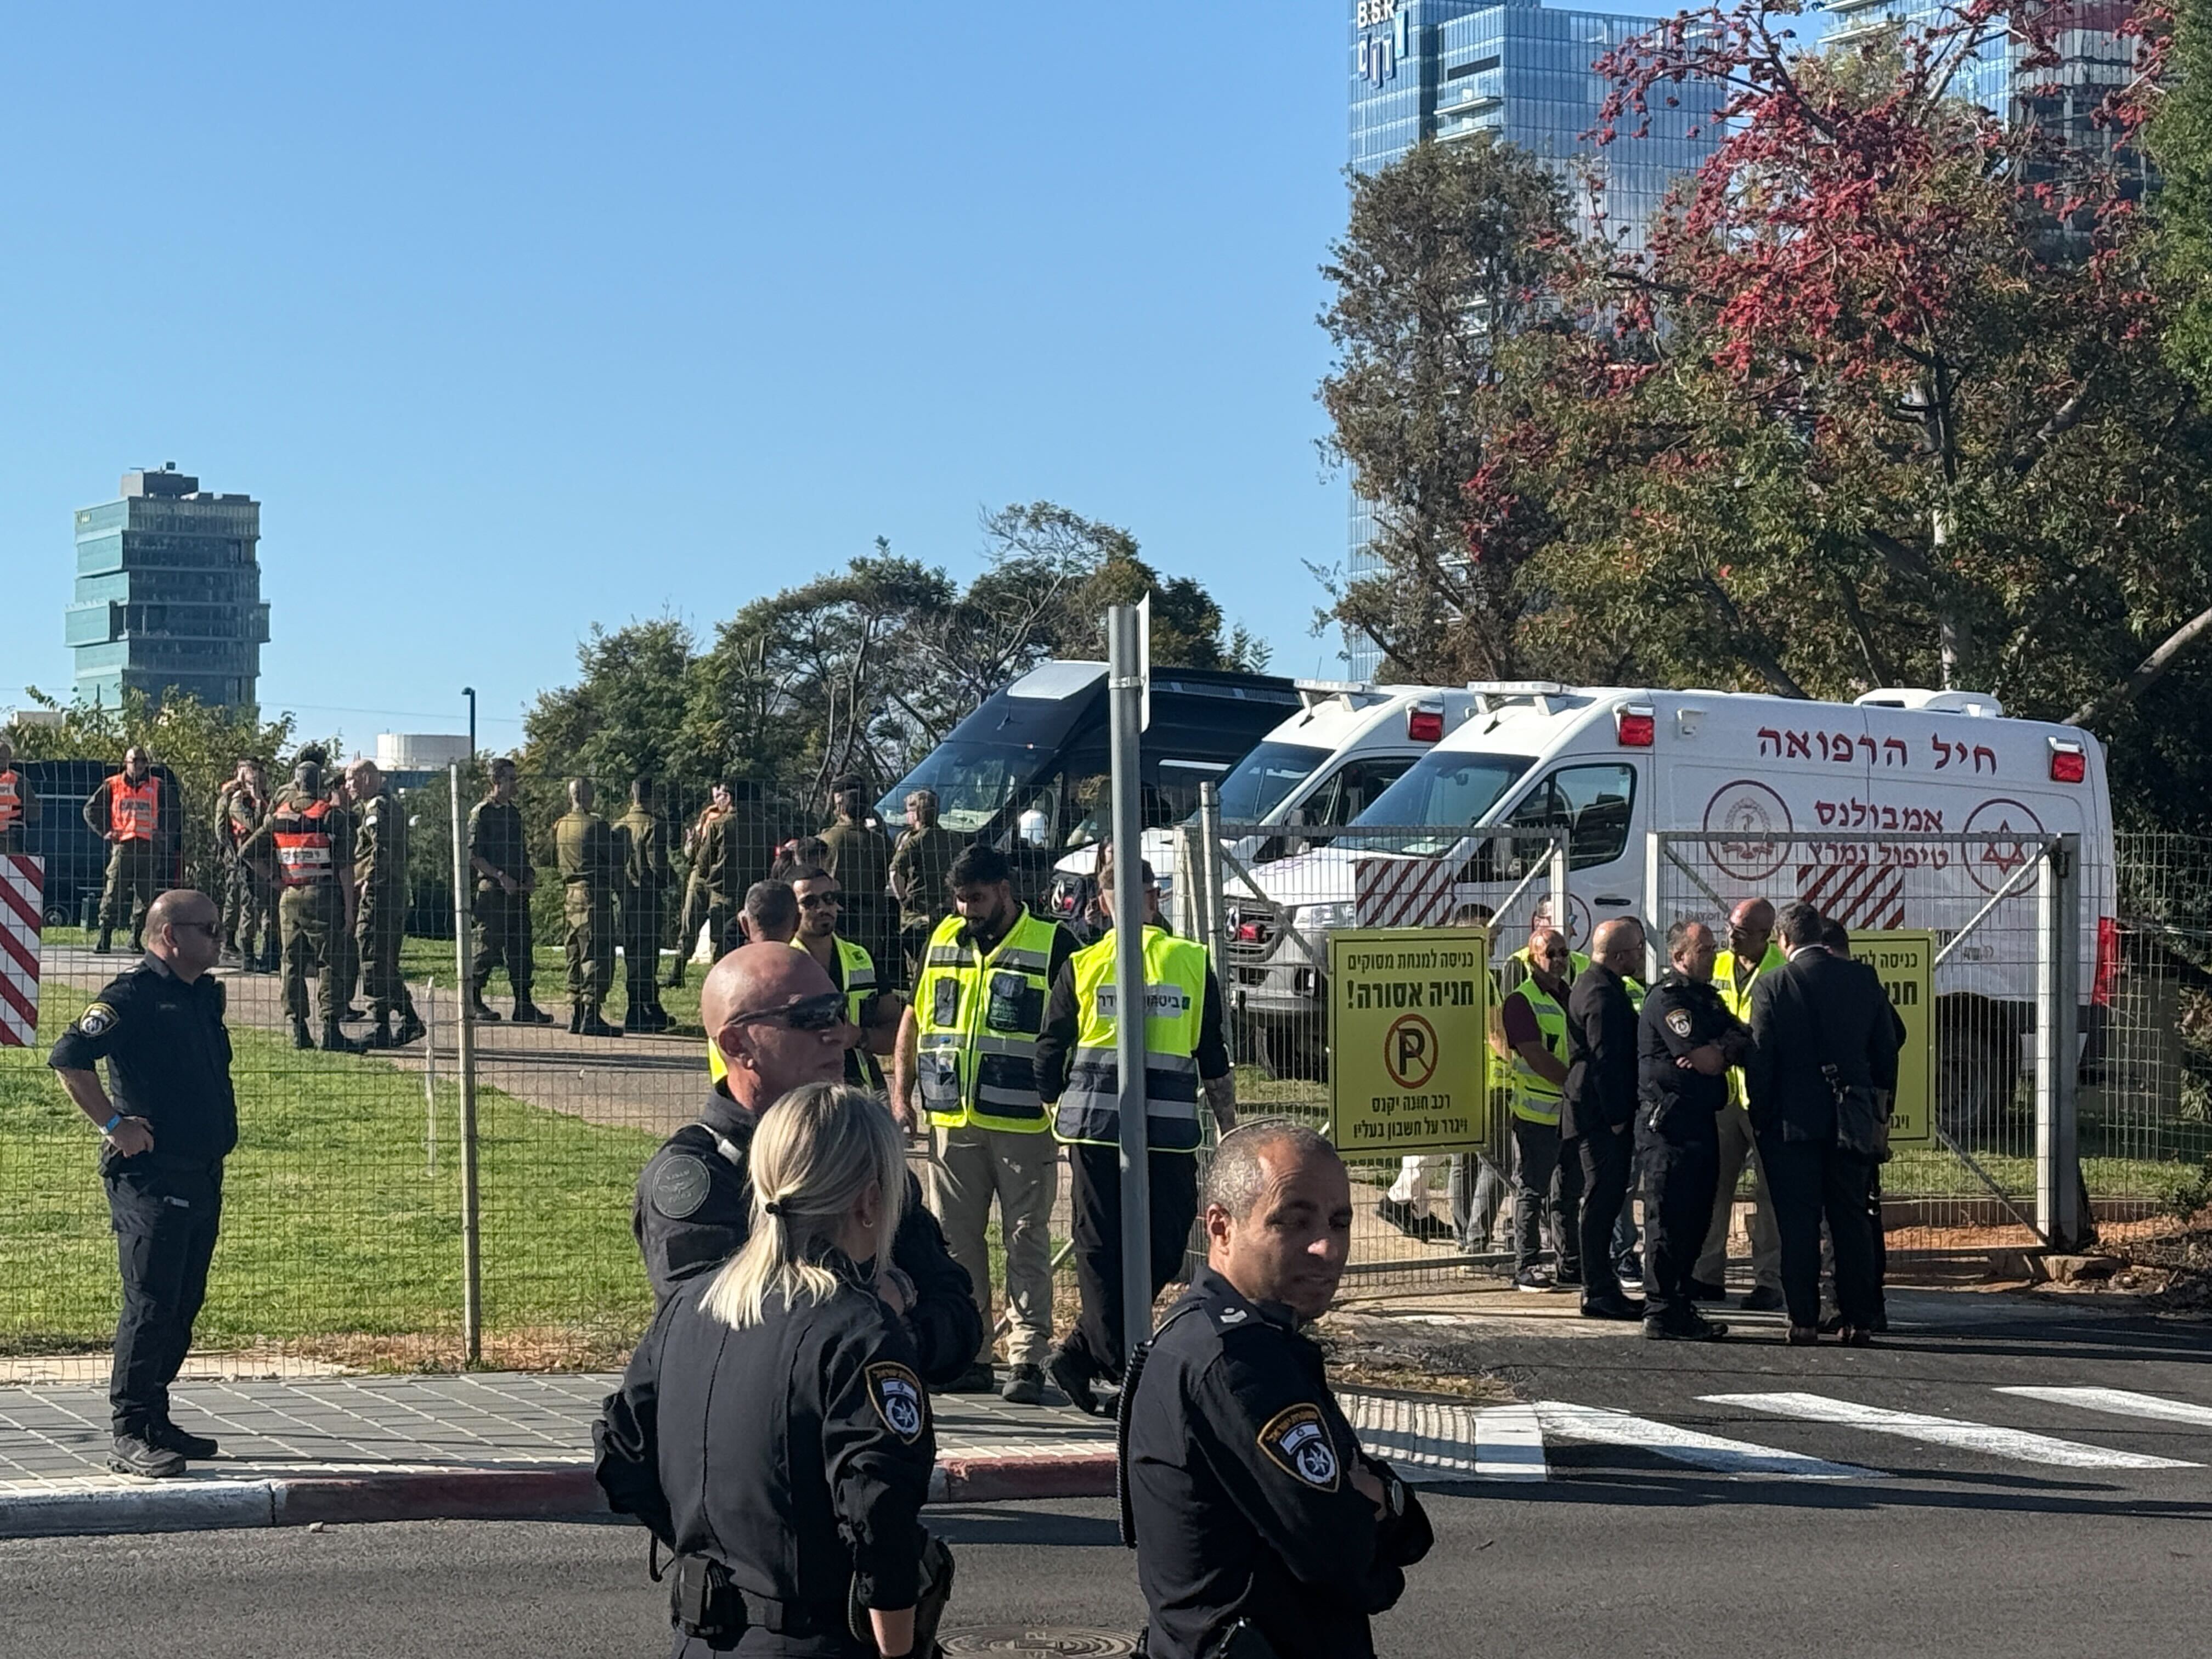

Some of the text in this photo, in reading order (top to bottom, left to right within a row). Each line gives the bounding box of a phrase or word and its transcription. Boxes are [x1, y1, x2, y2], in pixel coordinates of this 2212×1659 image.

[1357, 0, 1395, 29] B.S.R
[1358, 13, 1405, 82] CITY
[1757, 726, 1997, 775] חיל הרפואה
[1814, 797, 1943, 833] אמבולנס
[1809, 842, 1949, 870] טיפול נמרץ
[1348, 948, 1474, 974] כניסה למנחת מסוקים
[1880, 953, 1918, 968] כניסה
[1347, 980, 1474, 1009] חניה אסורה!
[1884, 981, 1918, 1005] חני
[1372, 1094, 1451, 1116] רכב חונה יקנס
[1353, 1116, 1468, 1141] ויגרר על חשבון בעליו
[1891, 1114, 1910, 1130] ויג
